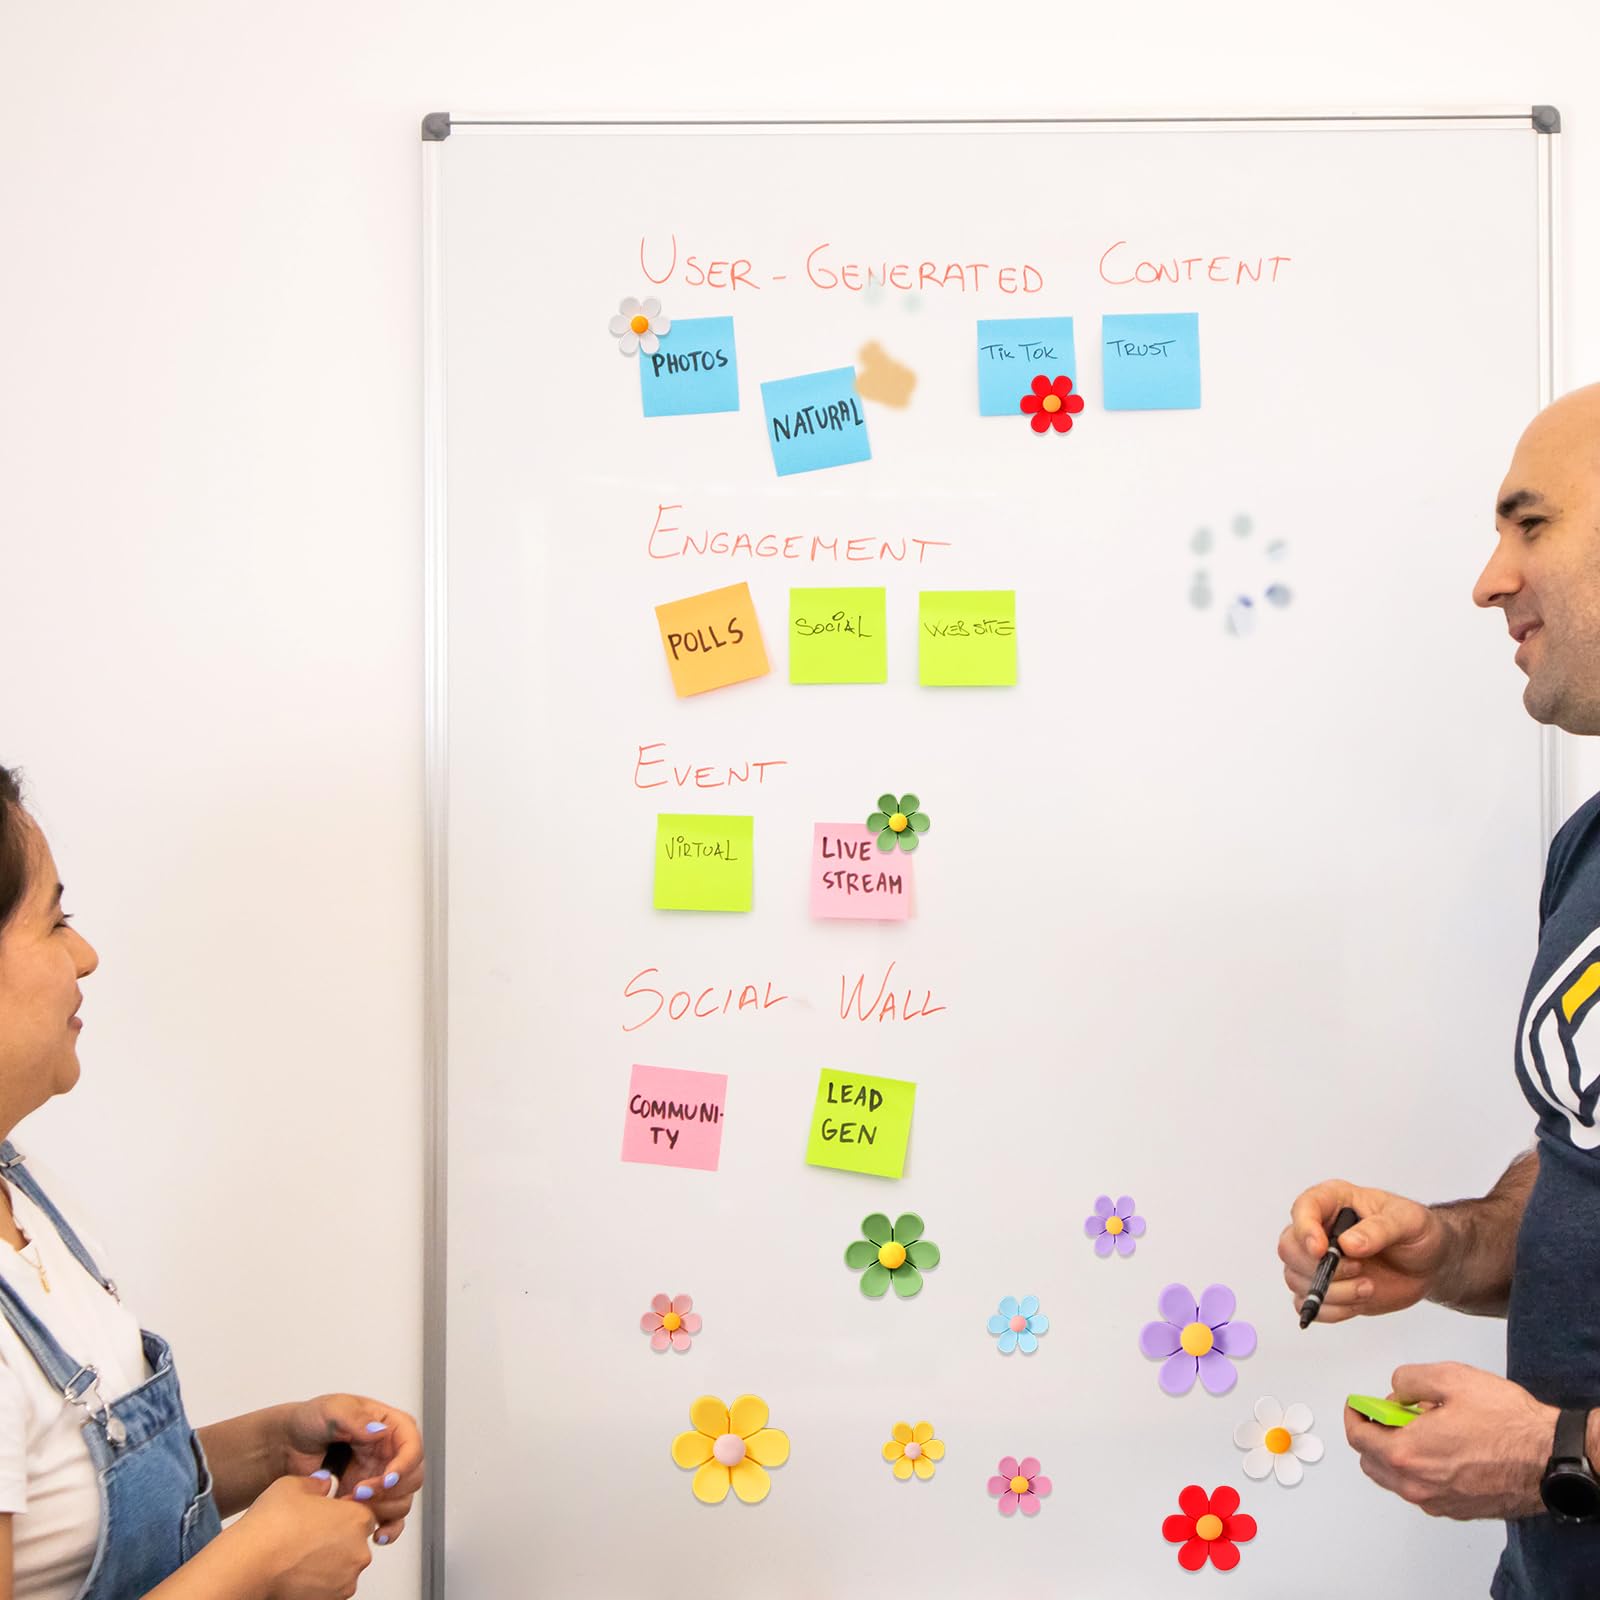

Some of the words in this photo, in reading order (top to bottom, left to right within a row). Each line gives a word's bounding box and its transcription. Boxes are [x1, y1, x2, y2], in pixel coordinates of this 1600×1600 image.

[1099, 240, 1292, 286] CONTENT
[651, 348, 729, 378] PHOTOS
[1106, 339, 1177, 358] TRUST
[772, 397, 864, 442] NATURAL
[647, 503, 952, 563] ENGAGEMENT
[667, 616, 744, 661] POLLS
[634, 742, 788, 790] EVENT
[822, 836, 872, 861] LIVE
[822, 870, 903, 895] STREAM
[622, 967, 789, 1033] SOCIAL
[839, 960, 948, 1023] WALL
[826, 1081, 884, 1113] LEAD
[649, 1126, 680, 1150] TY
[821, 1117, 878, 1146] GEN
